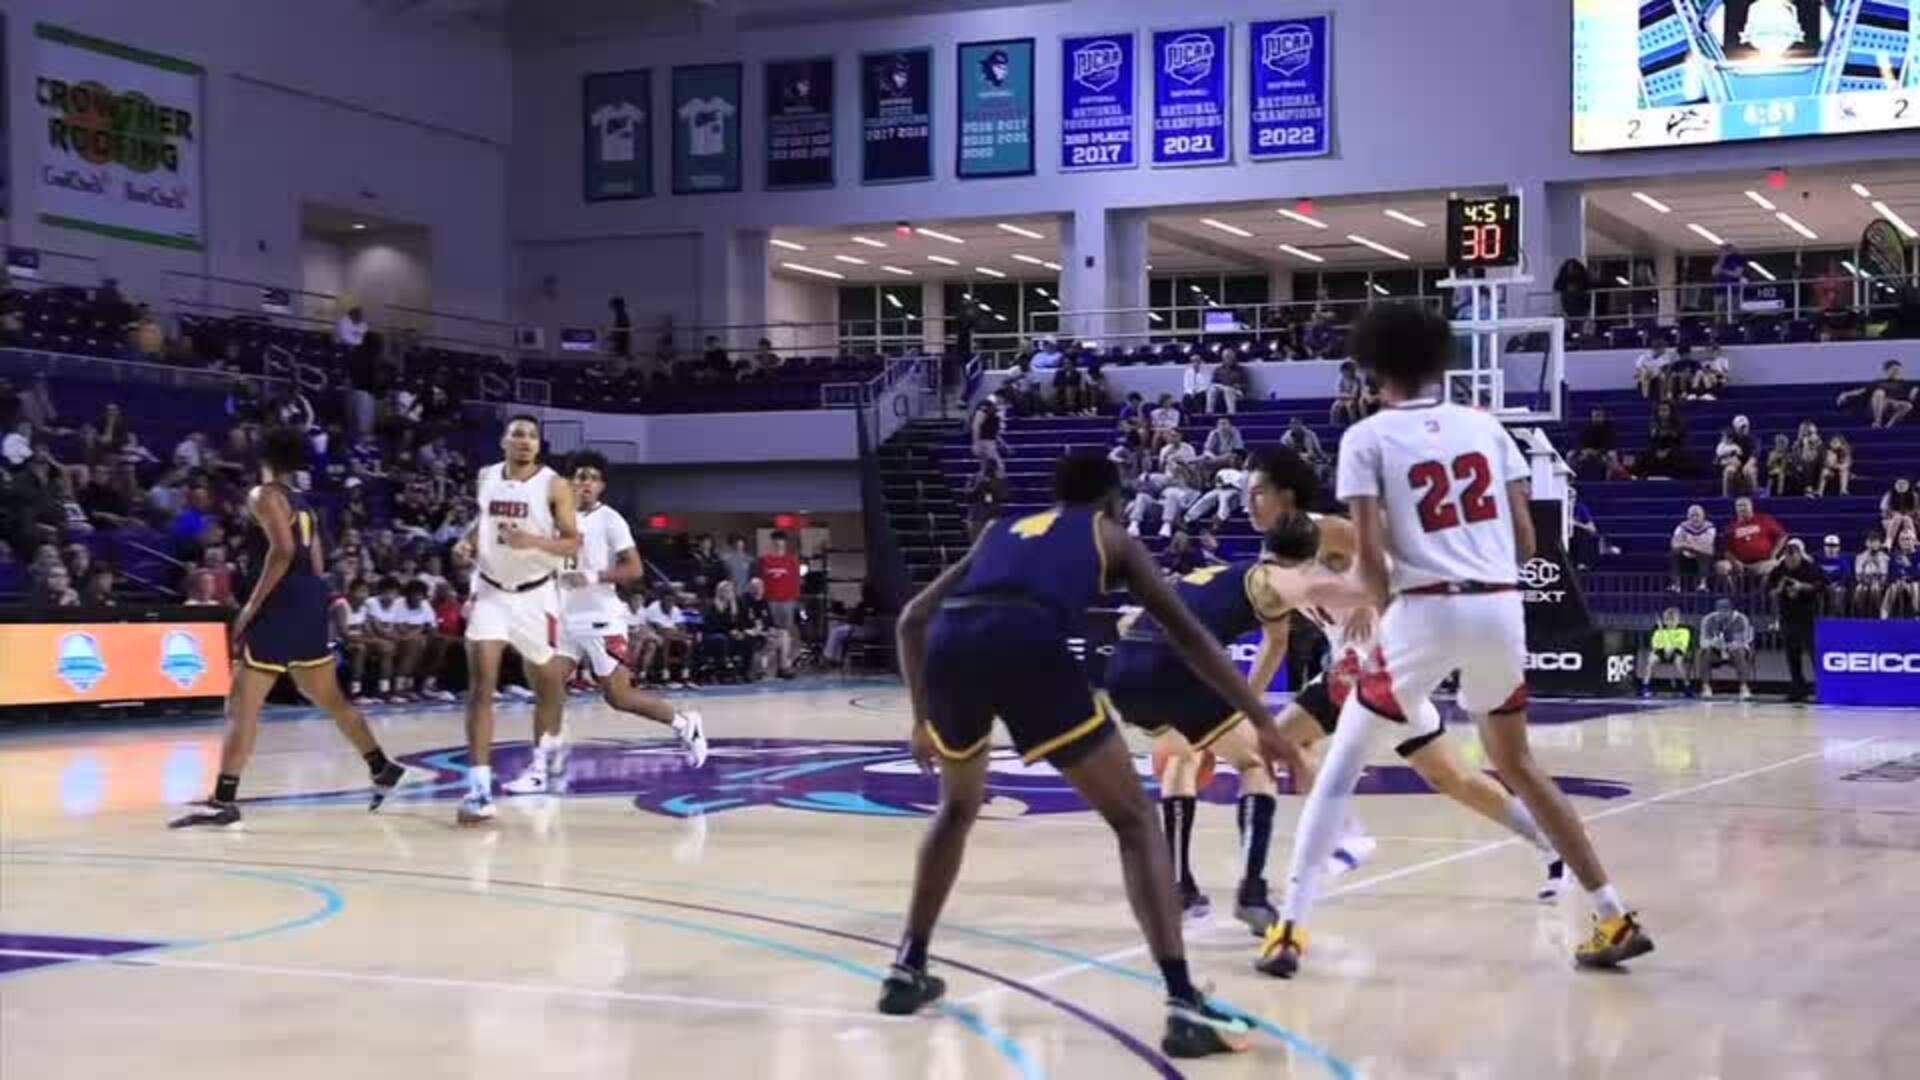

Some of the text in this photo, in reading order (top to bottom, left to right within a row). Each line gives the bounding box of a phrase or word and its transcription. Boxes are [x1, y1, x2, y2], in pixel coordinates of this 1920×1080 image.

[1893, 98, 1909, 119] 2
[1259, 126, 1315, 146] 2022
[1627, 119, 1642, 140] 2
[1072, 145, 1121, 163] 2017
[1164, 135, 1214, 154] 2021
[1464, 203, 1510, 222] 4:51
[1461, 225, 1501, 259] 30
[1408, 451, 1498, 533] 22
[1523, 591, 1566, 602] EXT
